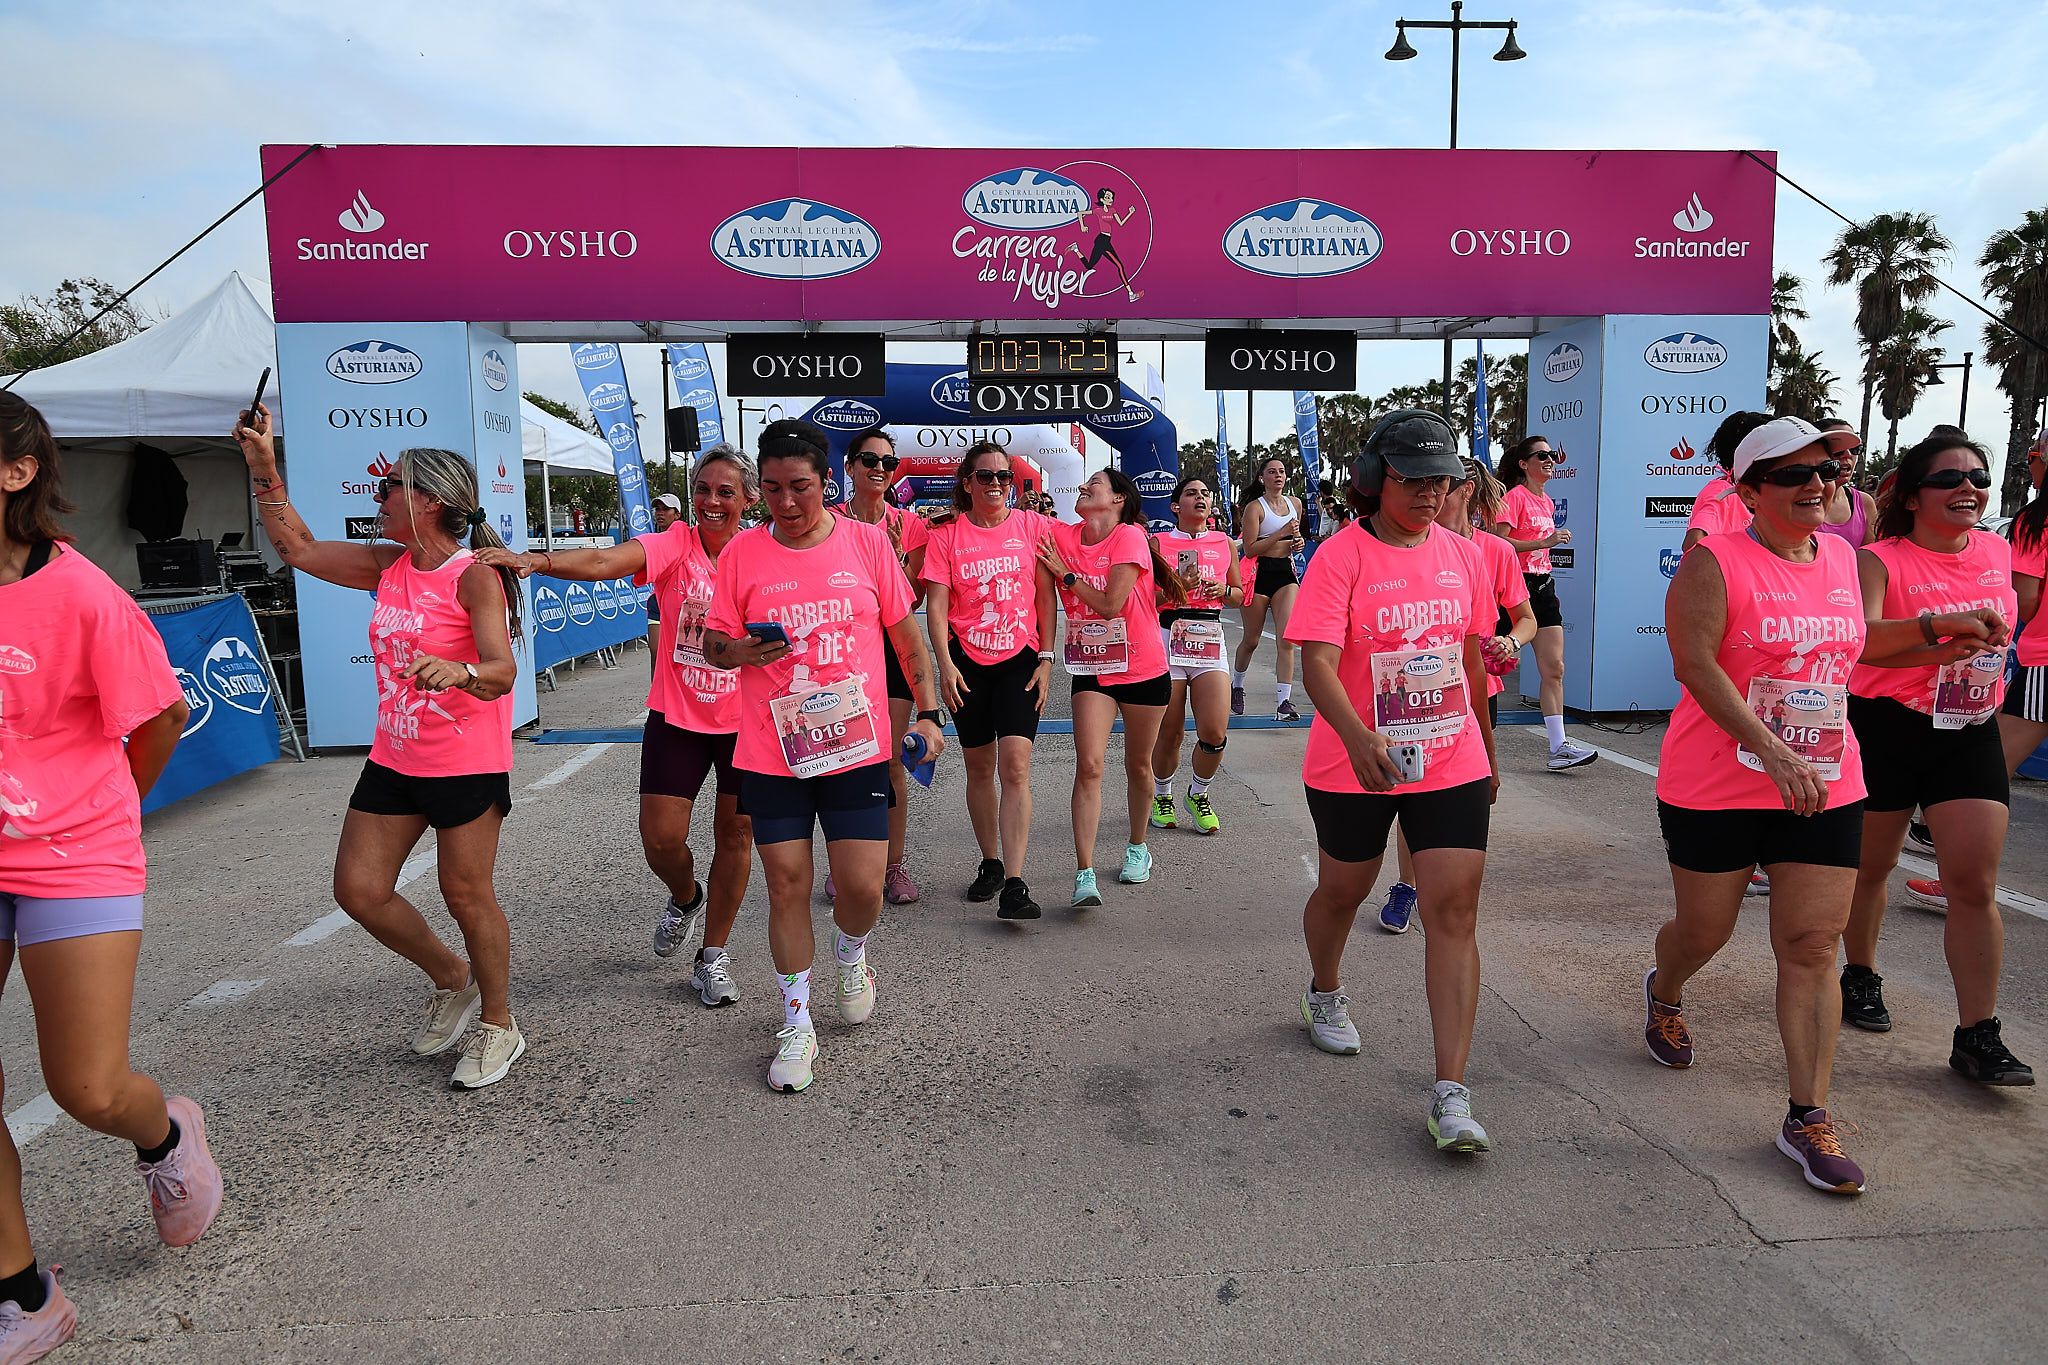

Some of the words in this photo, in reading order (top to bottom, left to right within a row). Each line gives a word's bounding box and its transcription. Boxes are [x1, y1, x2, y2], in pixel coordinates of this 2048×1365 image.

[973, 190, 1080, 214] ASTURIANA
[750, 226, 802, 235] CENTRAL
[808, 227, 862, 235] LECHERA
[1260, 226, 1310, 234] CENTRAL
[1315, 226, 1366, 234] LECHERA
[296, 238, 429, 261] Santander
[503, 230, 638, 259] OYSHO
[725, 228, 868, 258] ASTURIANA
[952, 225, 1058, 259] Carrera
[1235, 228, 1371, 257] ASTURIANA
[1450, 229, 1571, 256] OYSHO
[1634, 236, 1750, 259] Santander
[978, 260, 997, 282] de
[1001, 259, 1016, 282] la
[1013, 256, 1096, 308] Mujer
[1230, 348, 1336, 373] OYSHO
[1650, 347, 1721, 363] ASTURIANA
[334, 356, 416, 374] ASTURIANA
[752, 355, 862, 378] OYSHO
[1546, 358, 1580, 375] ASTURIANA
[939, 382, 970, 402] AST
[976, 383, 1114, 412] OYSHO
[1541, 399, 1583, 423] OYSHO
[1641, 395, 1727, 414] OYSHO
[328, 407, 428, 428] OYSHO
[484, 410, 511, 434] OYSHO
[817, 407, 875, 424] ASTURIANA
[1092, 411, 1149, 423] ASTURIANA
[916, 427, 1012, 448] OYSHO
[1039, 447, 1068, 455] OYSHO
[911, 456, 939, 467] Sports
[1646, 463, 1716, 476] Santander
[1551, 467, 1577, 480] ntander
[342, 481, 380, 495] Sant
[1650, 501, 1693, 516] Neutrog
[961, 555, 1021, 579] CARRERA
[1550, 554, 1572, 566] utrogena
[1661, 555, 1680, 571] Mar
[761, 580, 798, 596] OYSHO
[995, 577, 1012, 601] DE
[1367, 578, 1407, 595] OYSHO
[1908, 582, 1948, 595] OYSHO
[1753, 592, 1796, 602] OYSHO
[767, 597, 854, 628] CARRERA
[1377, 599, 1463, 634] CARRERA
[1636, 625, 1666, 636] octop
[1761, 615, 1859, 643] CARRERA
[967, 627, 1015, 650] MUJER
[1185, 641, 1205, 650] 016
[817, 630, 844, 665] DE
[1083, 645, 1107, 655] 016
[0, 658, 31, 671] URIANA
[350, 655, 375, 664] octo
[682, 655, 706, 664] OYSHO
[682, 666, 737, 693] MUJER
[696, 692, 717, 703] 2026
[1408, 689, 1443, 707] 016
[1760, 686, 1783, 696] SUMA
[780, 702, 799, 712] SUMA
[804, 697, 839, 712] ASTURIANA
[1788, 695, 1826, 707] ASTURIANA
[811, 722, 847, 742] 016
[1387, 727, 1420, 737] OYSHO
[1437, 722, 1461, 732] Santander
[1782, 725, 1820, 744] 016
[796, 755, 817, 764] CARRERA
[846, 747, 870, 761] Santander
[800, 760, 829, 774] OYSHO
